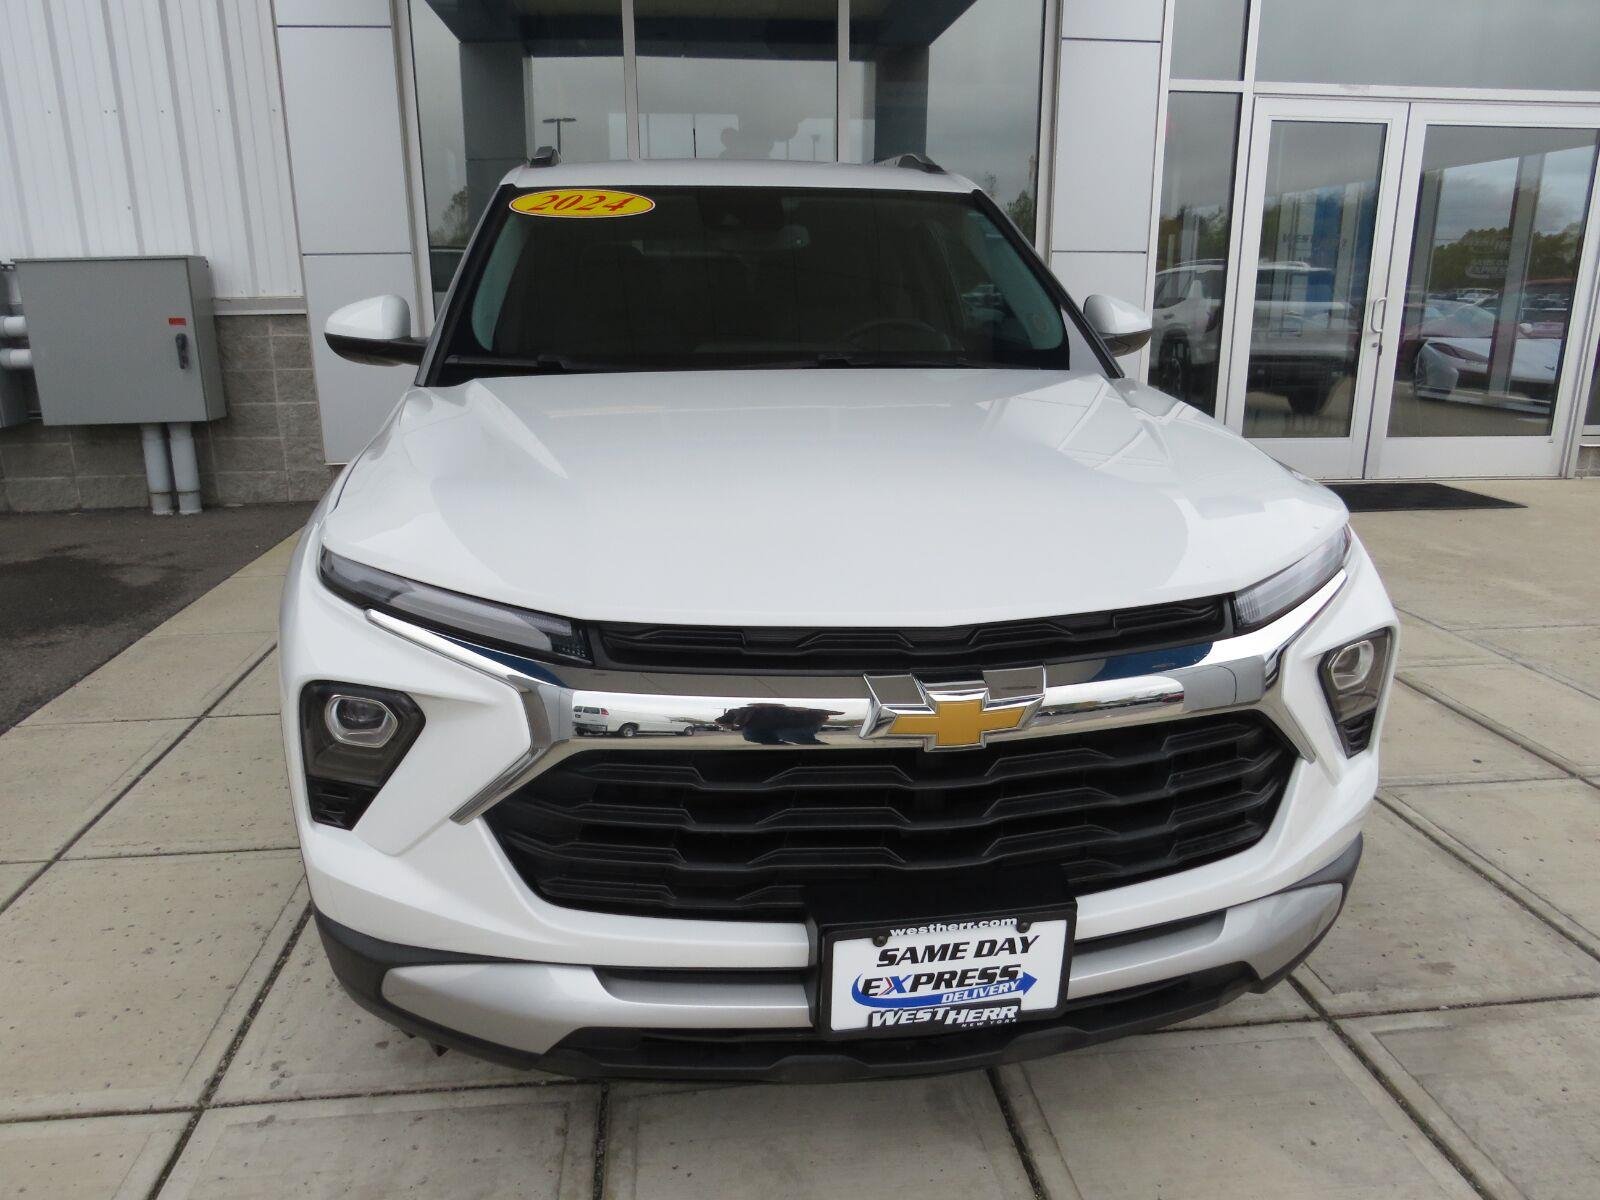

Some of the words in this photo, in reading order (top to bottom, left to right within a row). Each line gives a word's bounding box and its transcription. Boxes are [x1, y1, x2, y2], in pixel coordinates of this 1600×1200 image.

[528, 194, 635, 212] 2024
[890, 917, 1018, 937] westherr.com
[876, 941, 969, 968] SAME
[973, 934, 1040, 958] DAY
[861, 964, 1021, 996] EXPRESS
[941, 981, 1019, 1003] DELIVERY
